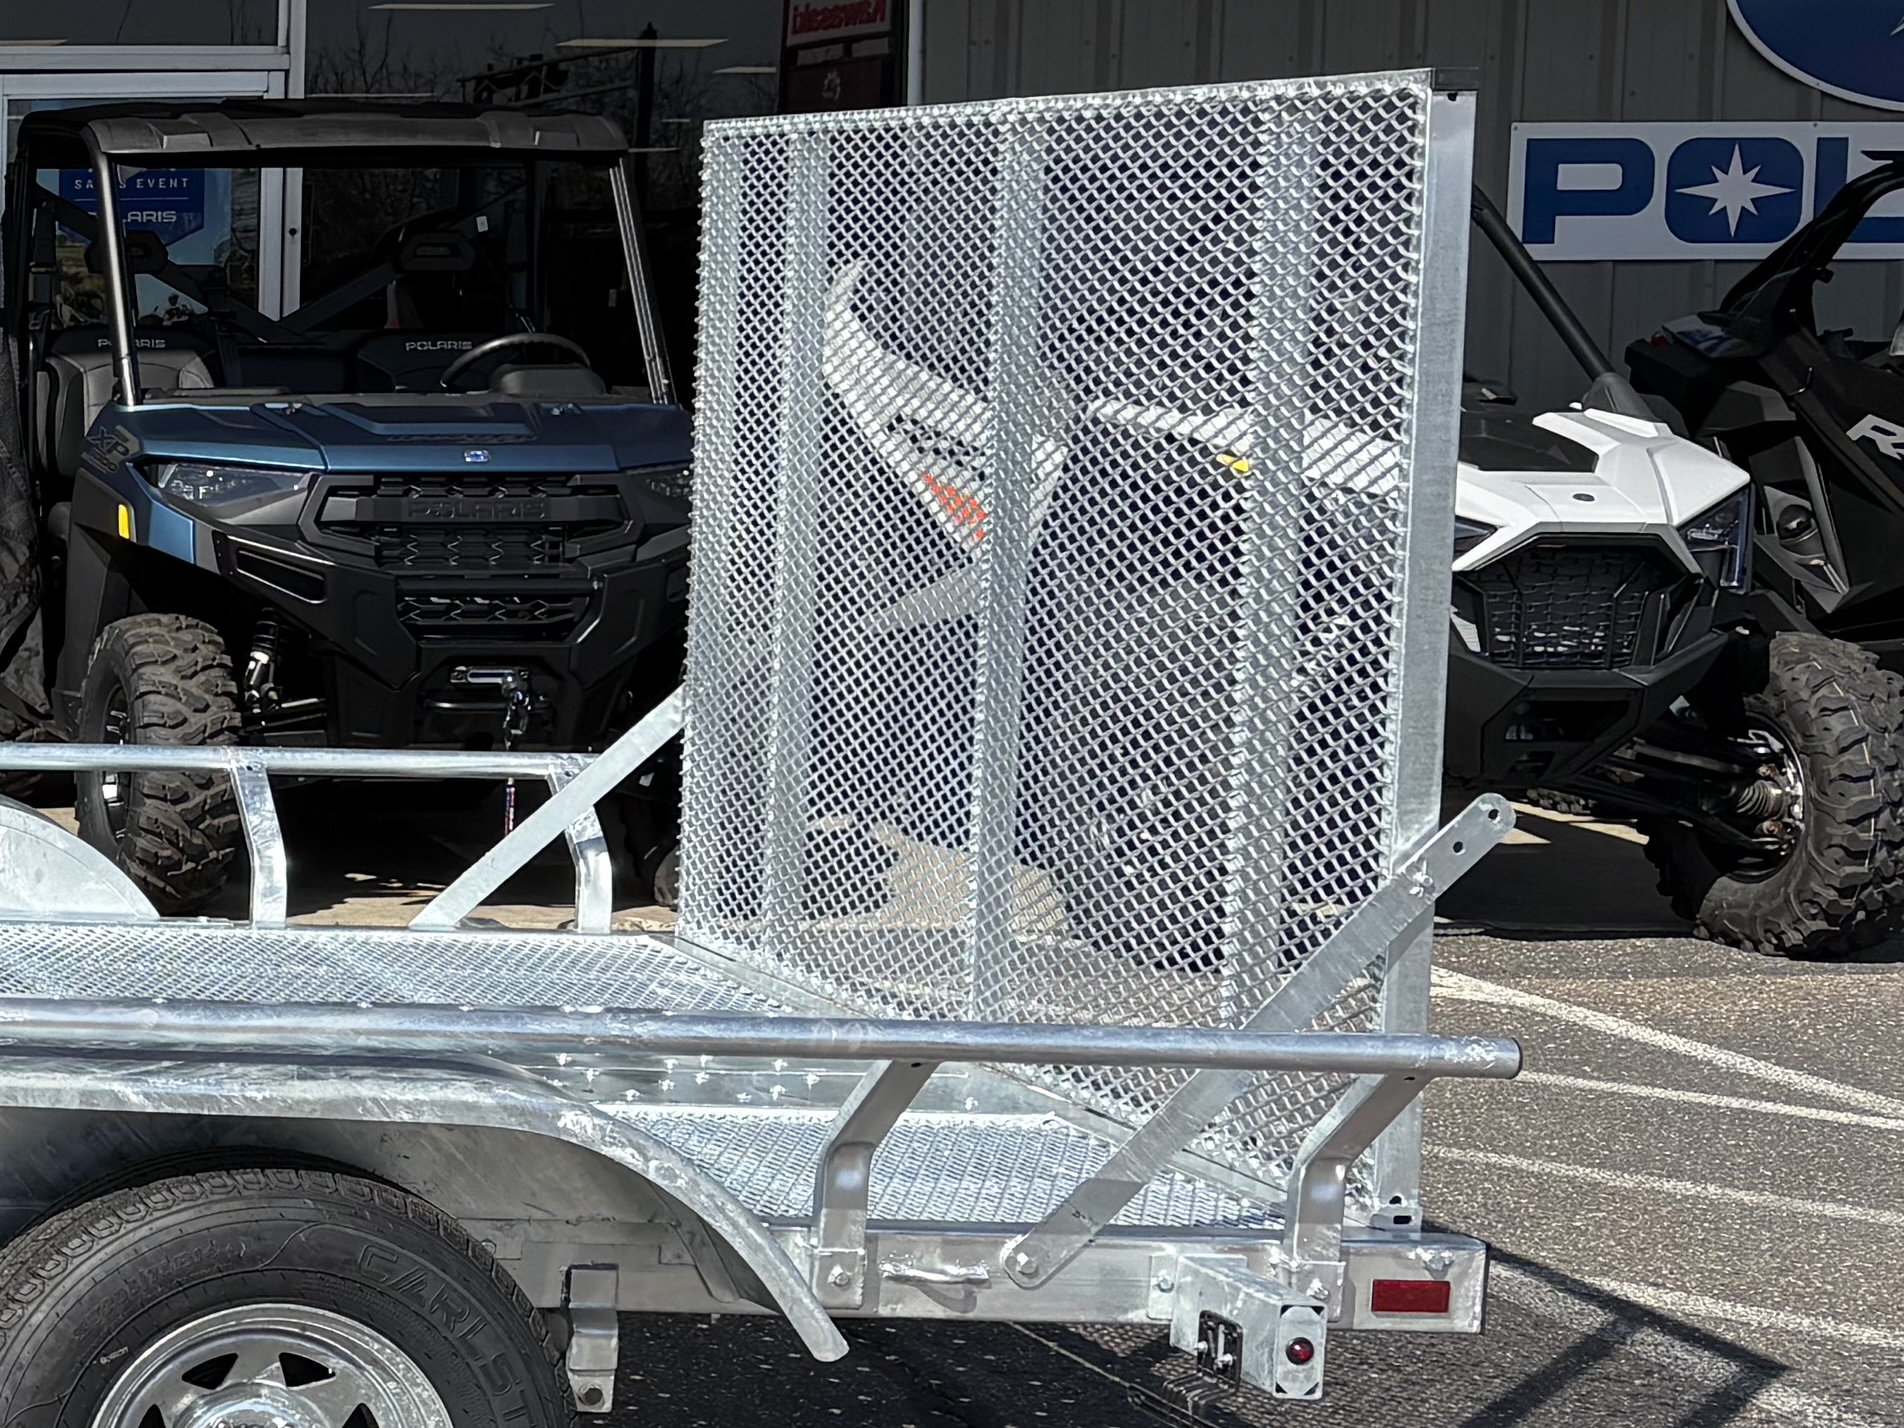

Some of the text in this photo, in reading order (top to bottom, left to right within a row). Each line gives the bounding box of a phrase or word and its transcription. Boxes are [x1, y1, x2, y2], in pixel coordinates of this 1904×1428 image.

[136, 177, 190, 189] EVENT
[405, 340, 473, 352] POLARIS
[86, 426, 130, 457] XP
[408, 500, 546, 519] POLARIS
